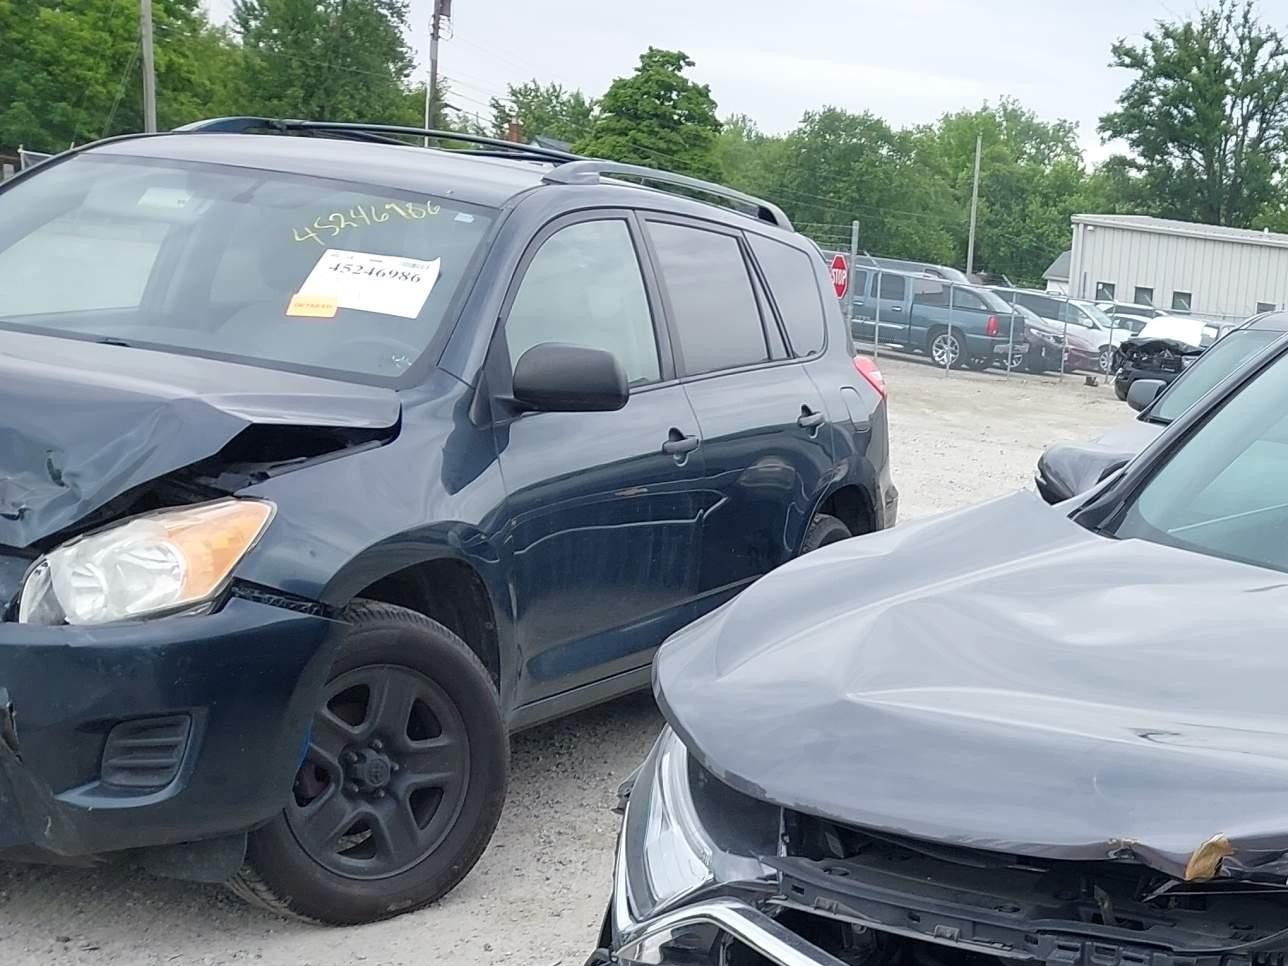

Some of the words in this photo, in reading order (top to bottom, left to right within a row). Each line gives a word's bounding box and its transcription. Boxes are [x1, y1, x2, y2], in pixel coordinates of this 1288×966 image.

[292, 200, 441, 246] 45246986
[328, 261, 422, 284] 45246986
[831, 268, 847, 285] STOP
